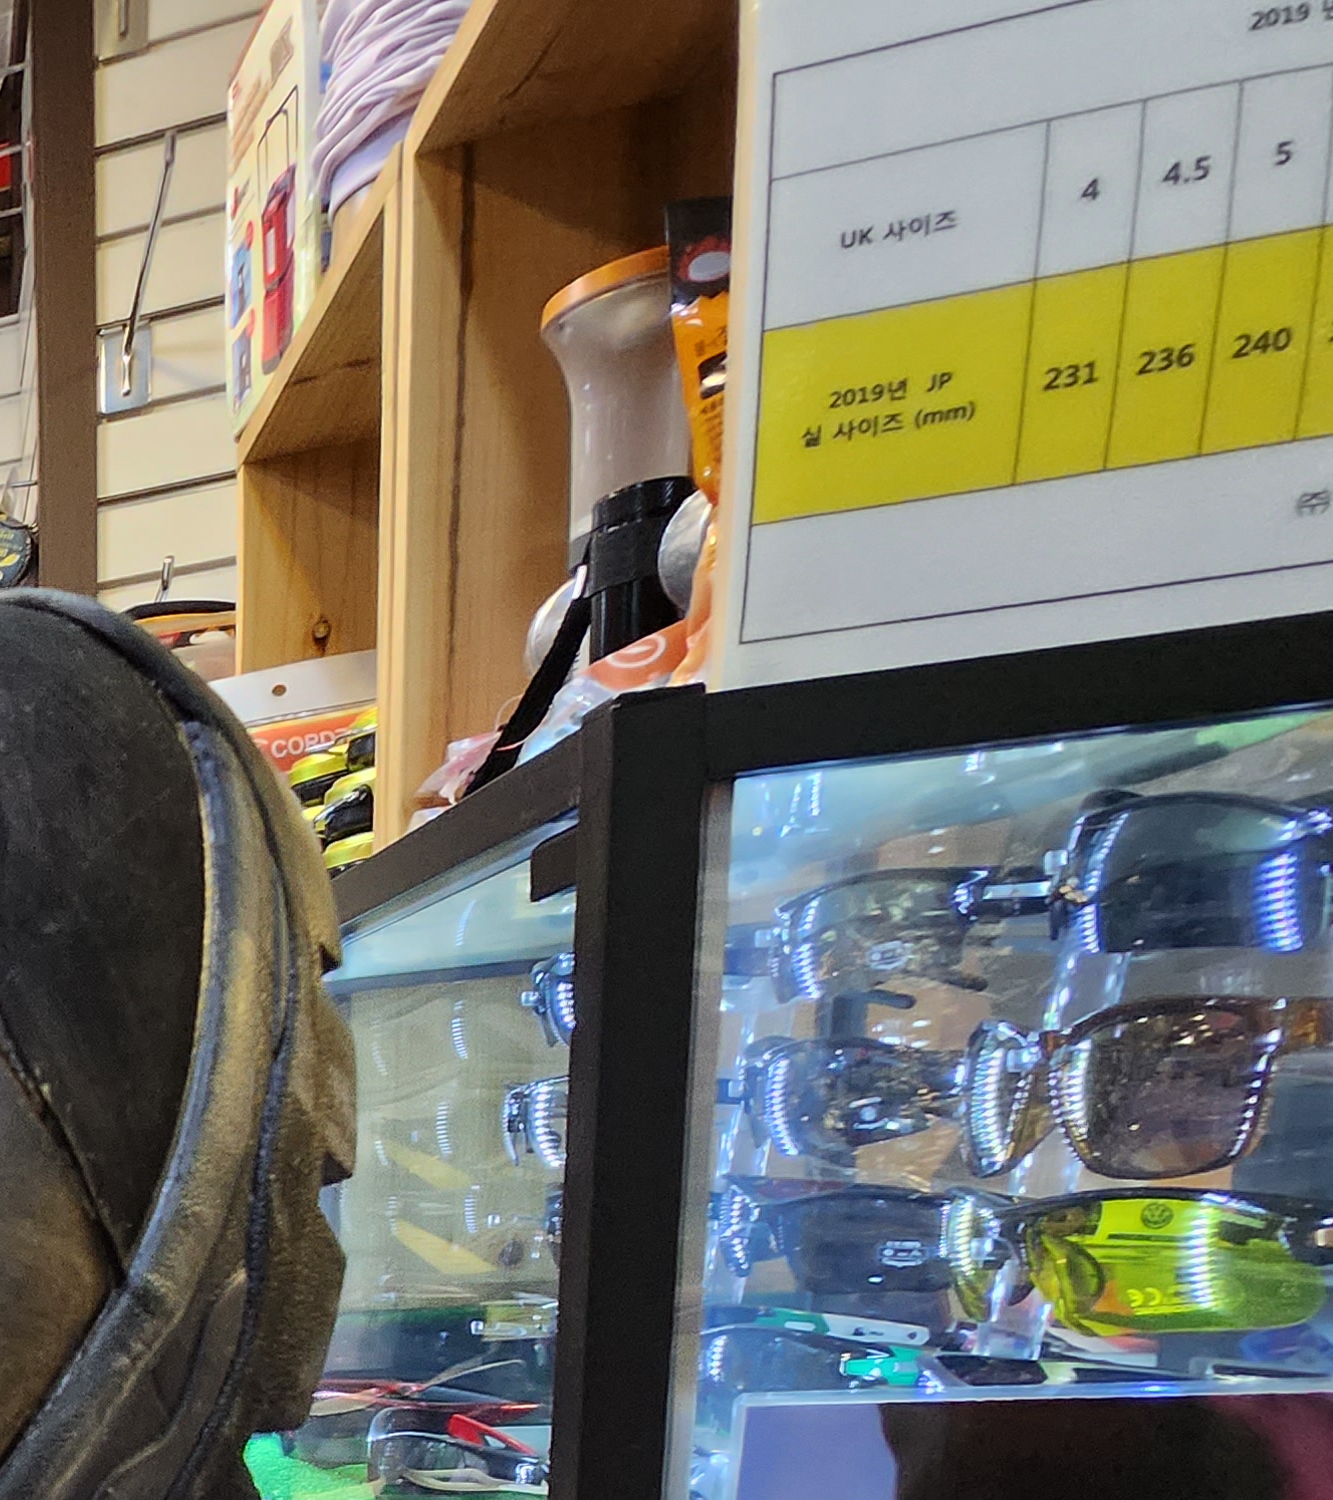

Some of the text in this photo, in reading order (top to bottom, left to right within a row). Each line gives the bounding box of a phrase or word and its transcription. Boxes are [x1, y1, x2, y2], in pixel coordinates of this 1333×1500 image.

[1249, 2, 1310, 31] 2019
[1274, 140, 1294, 166] 5
[1162, 156, 1211, 185] 4.5
[1080, 179, 1100, 202] 4
[839, 208, 959, 250] UK 사이즈
[1232, 327, 1292, 359] 240
[1135, 345, 1196, 376] 236
[828, 371, 954, 410] 2019년 JP
[1044, 361, 1099, 391] 231
[833, 409, 905, 443] 사이즈
[913, 400, 977, 430] (mm)
